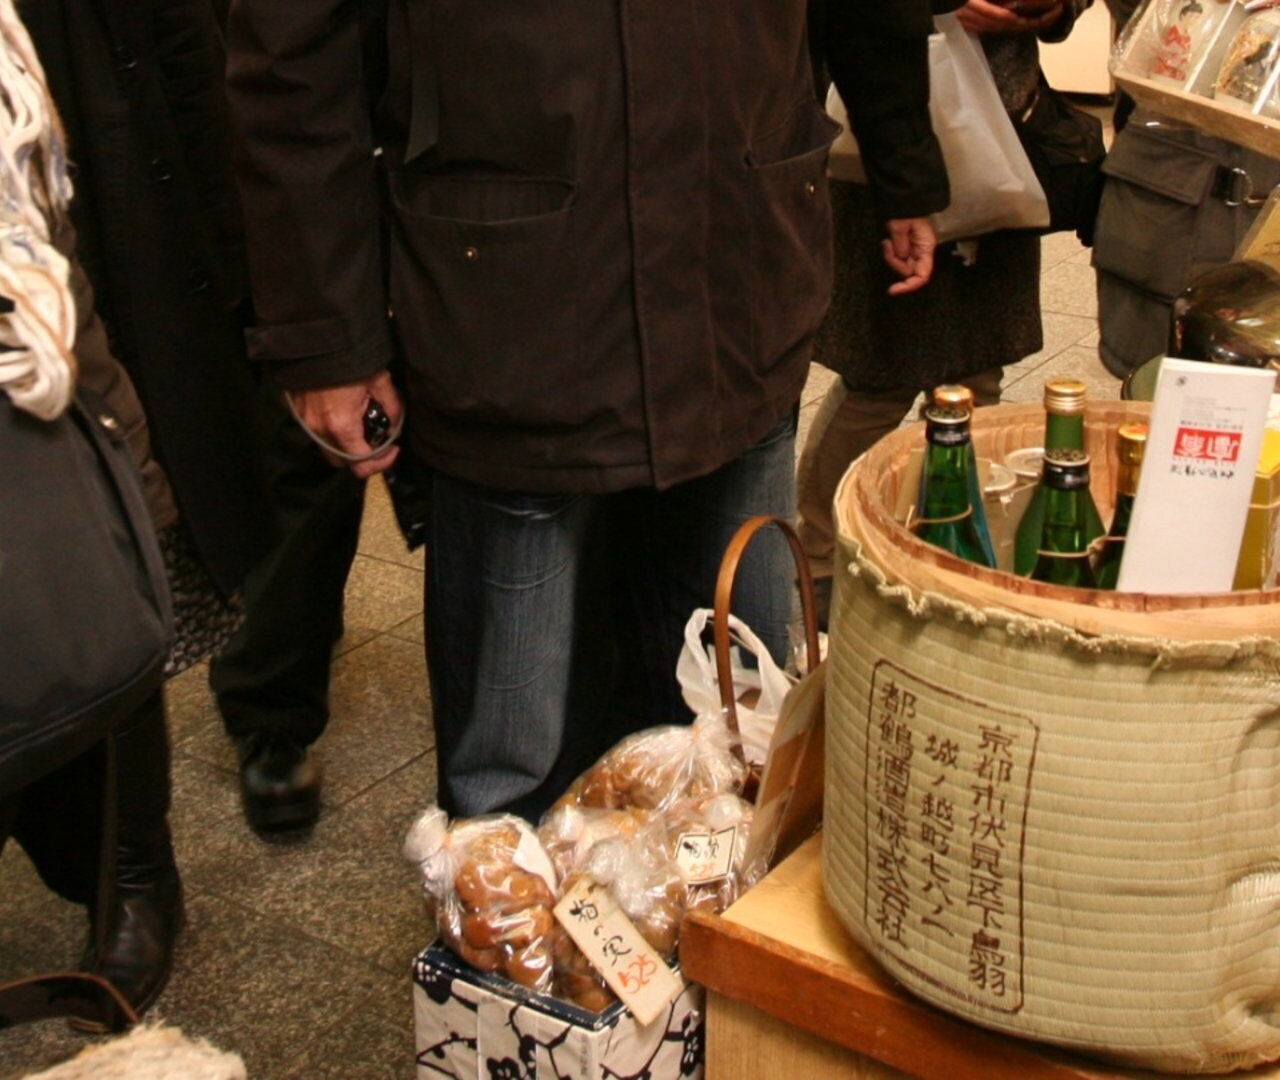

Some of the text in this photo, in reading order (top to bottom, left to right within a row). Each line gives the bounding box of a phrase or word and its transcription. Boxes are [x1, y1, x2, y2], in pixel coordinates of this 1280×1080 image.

[967, 724, 1021, 998] 京都市伏見区下鳥羽
